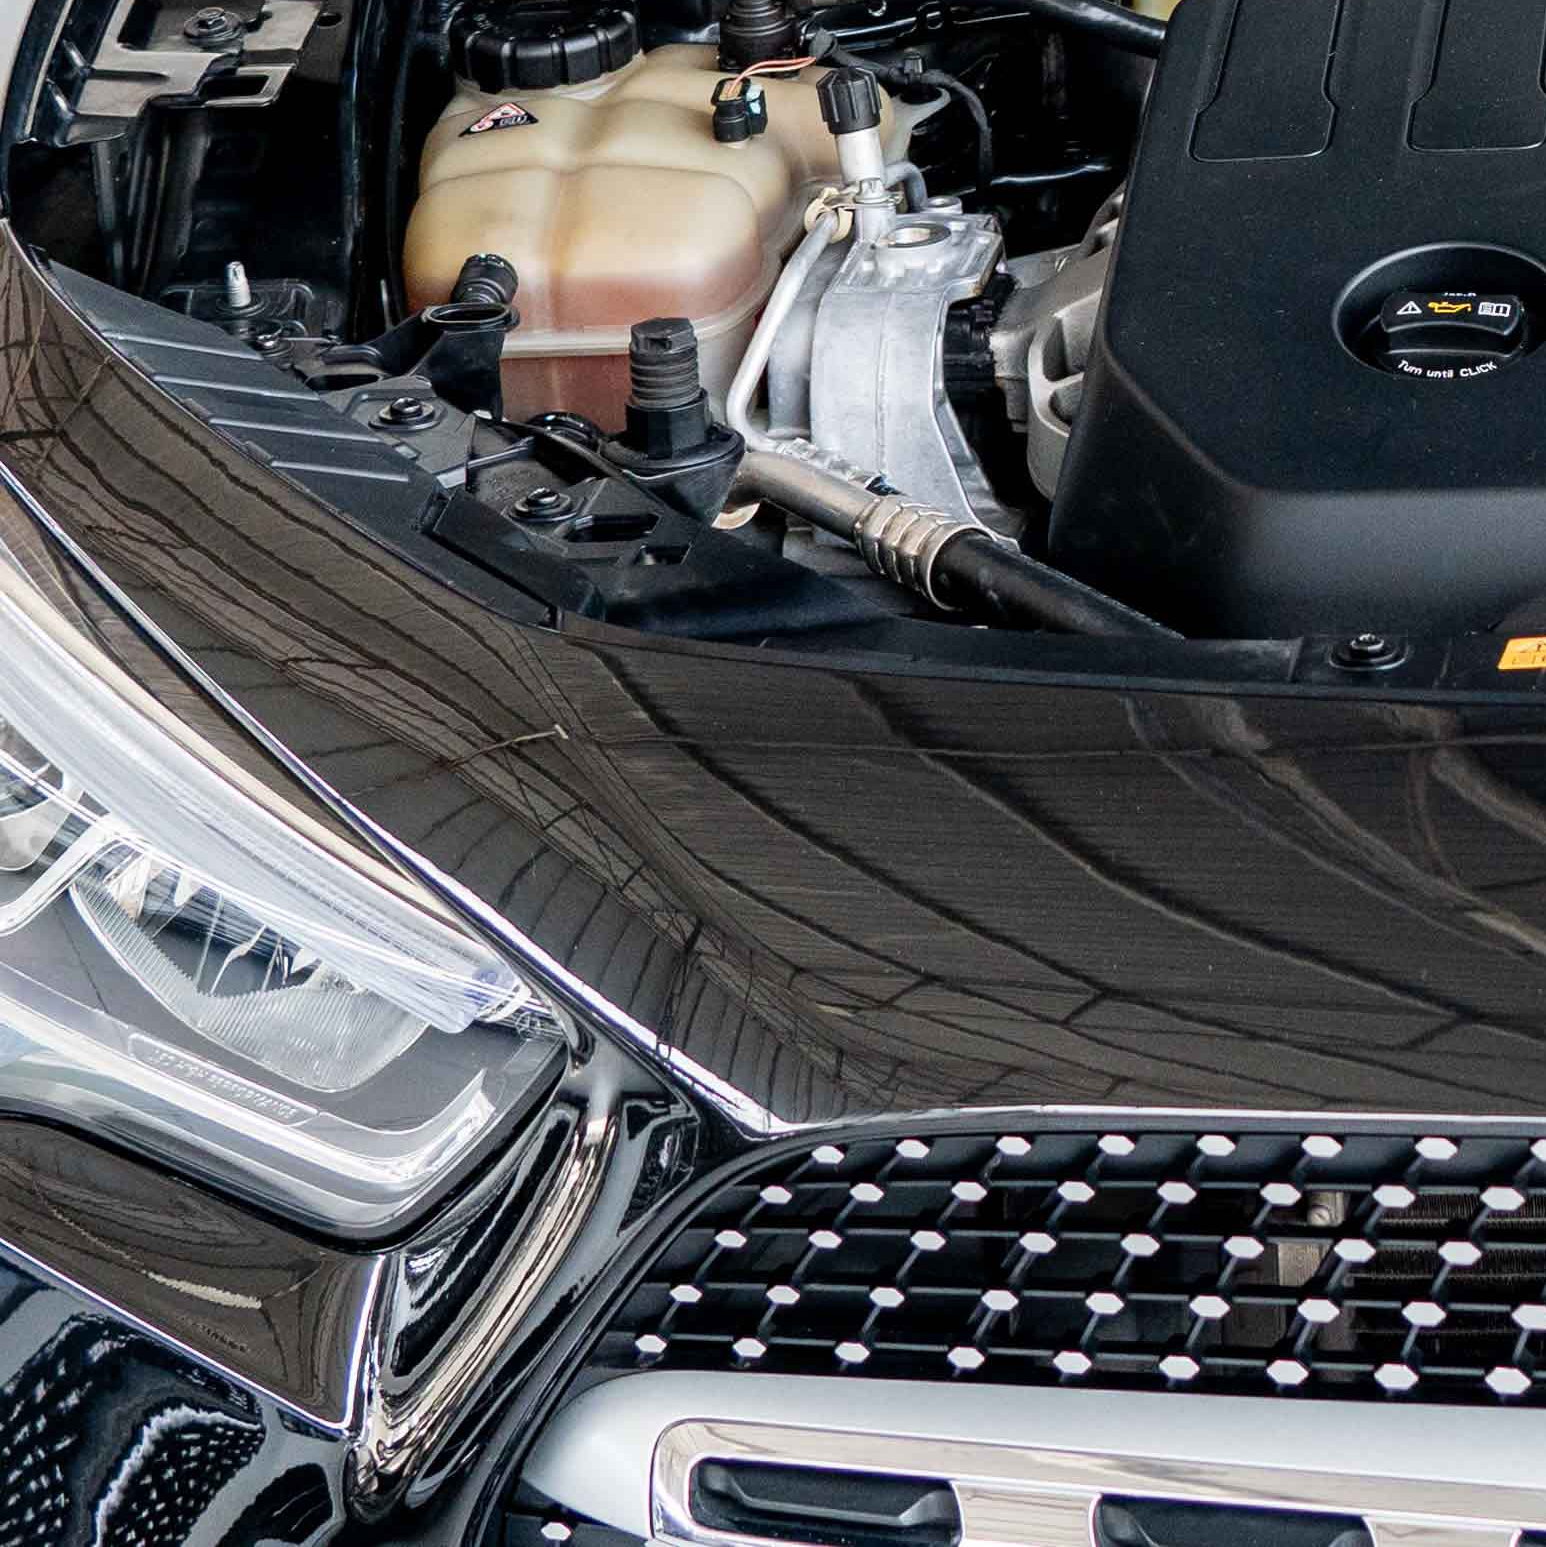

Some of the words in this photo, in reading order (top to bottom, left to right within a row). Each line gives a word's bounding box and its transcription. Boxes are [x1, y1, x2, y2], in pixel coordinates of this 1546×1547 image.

[1398, 359, 1423, 376] Turn
[1426, 369, 1454, 379] until
[1459, 360, 1498, 377] CLICK
